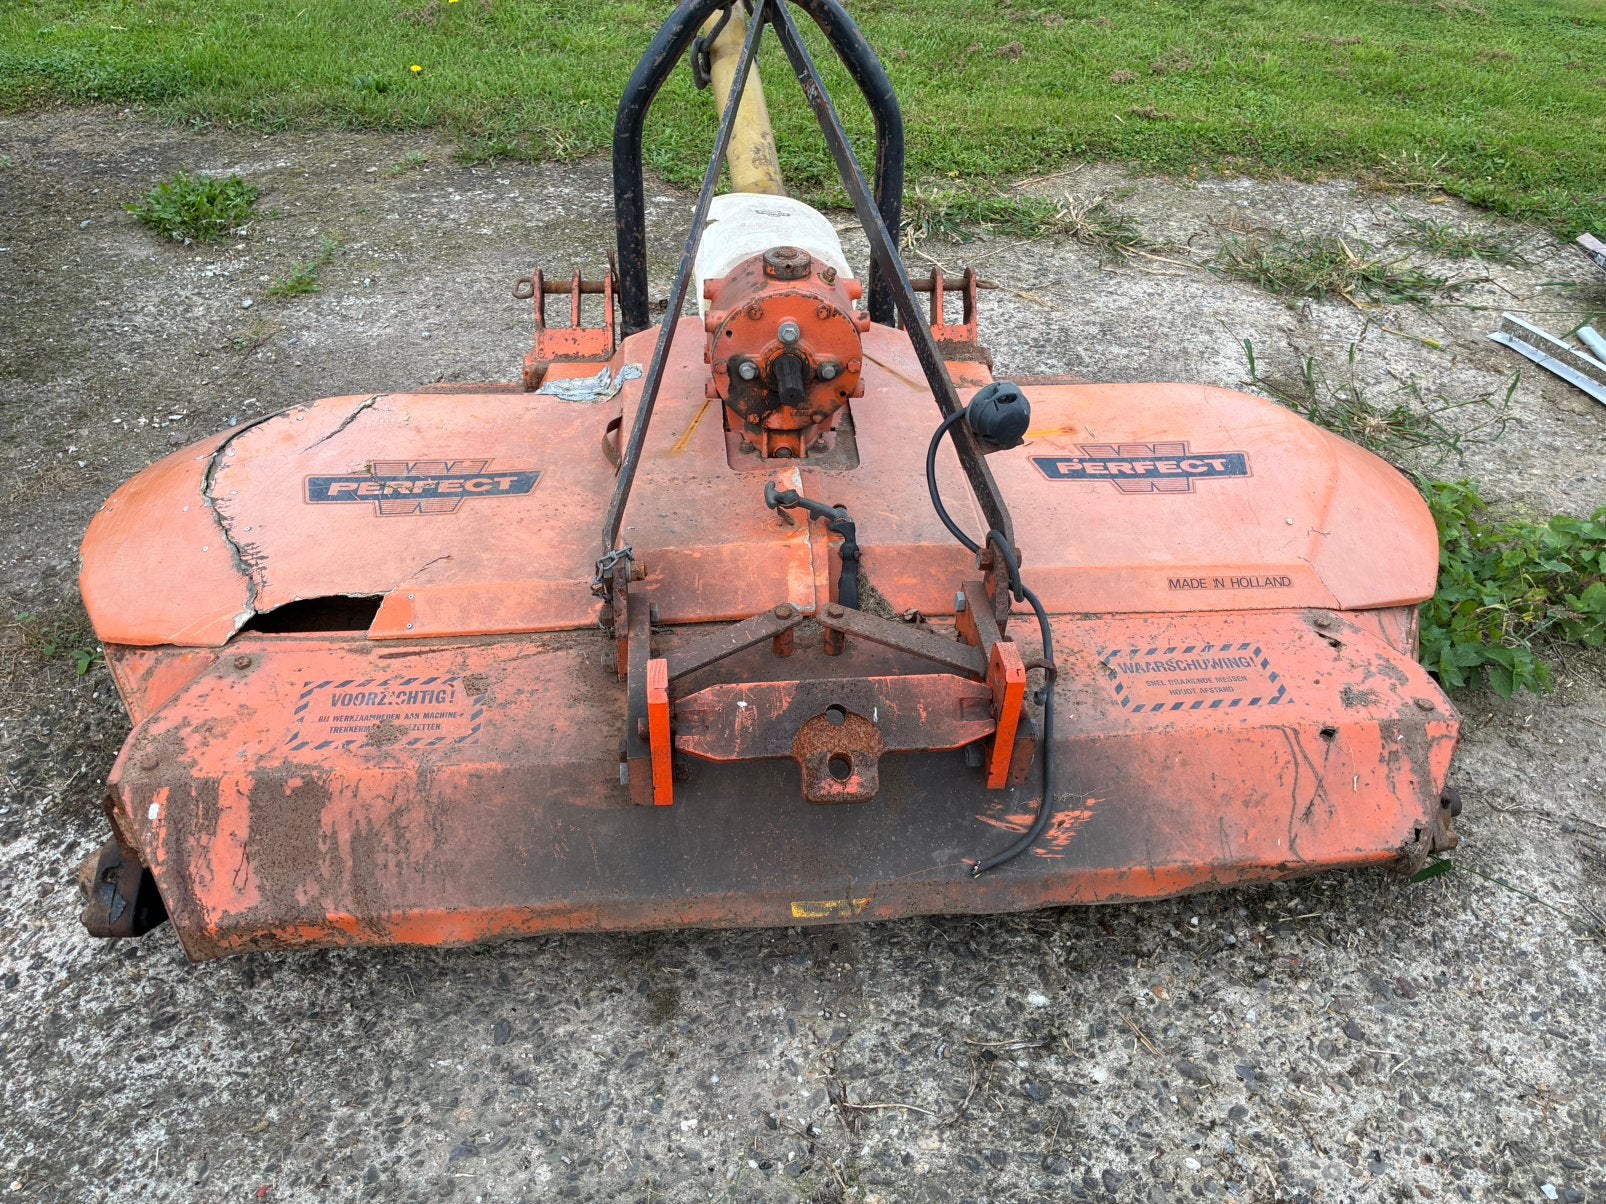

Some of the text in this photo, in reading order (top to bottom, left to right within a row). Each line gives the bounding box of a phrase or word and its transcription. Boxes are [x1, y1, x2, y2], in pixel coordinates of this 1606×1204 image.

[1056, 458, 1227, 474] PERFECT
[327, 476, 518, 496] PERFECT
[1168, 576, 1292, 589] MADE IN HOLLAND
[1117, 656, 1257, 674] WAARSCHUWING!
